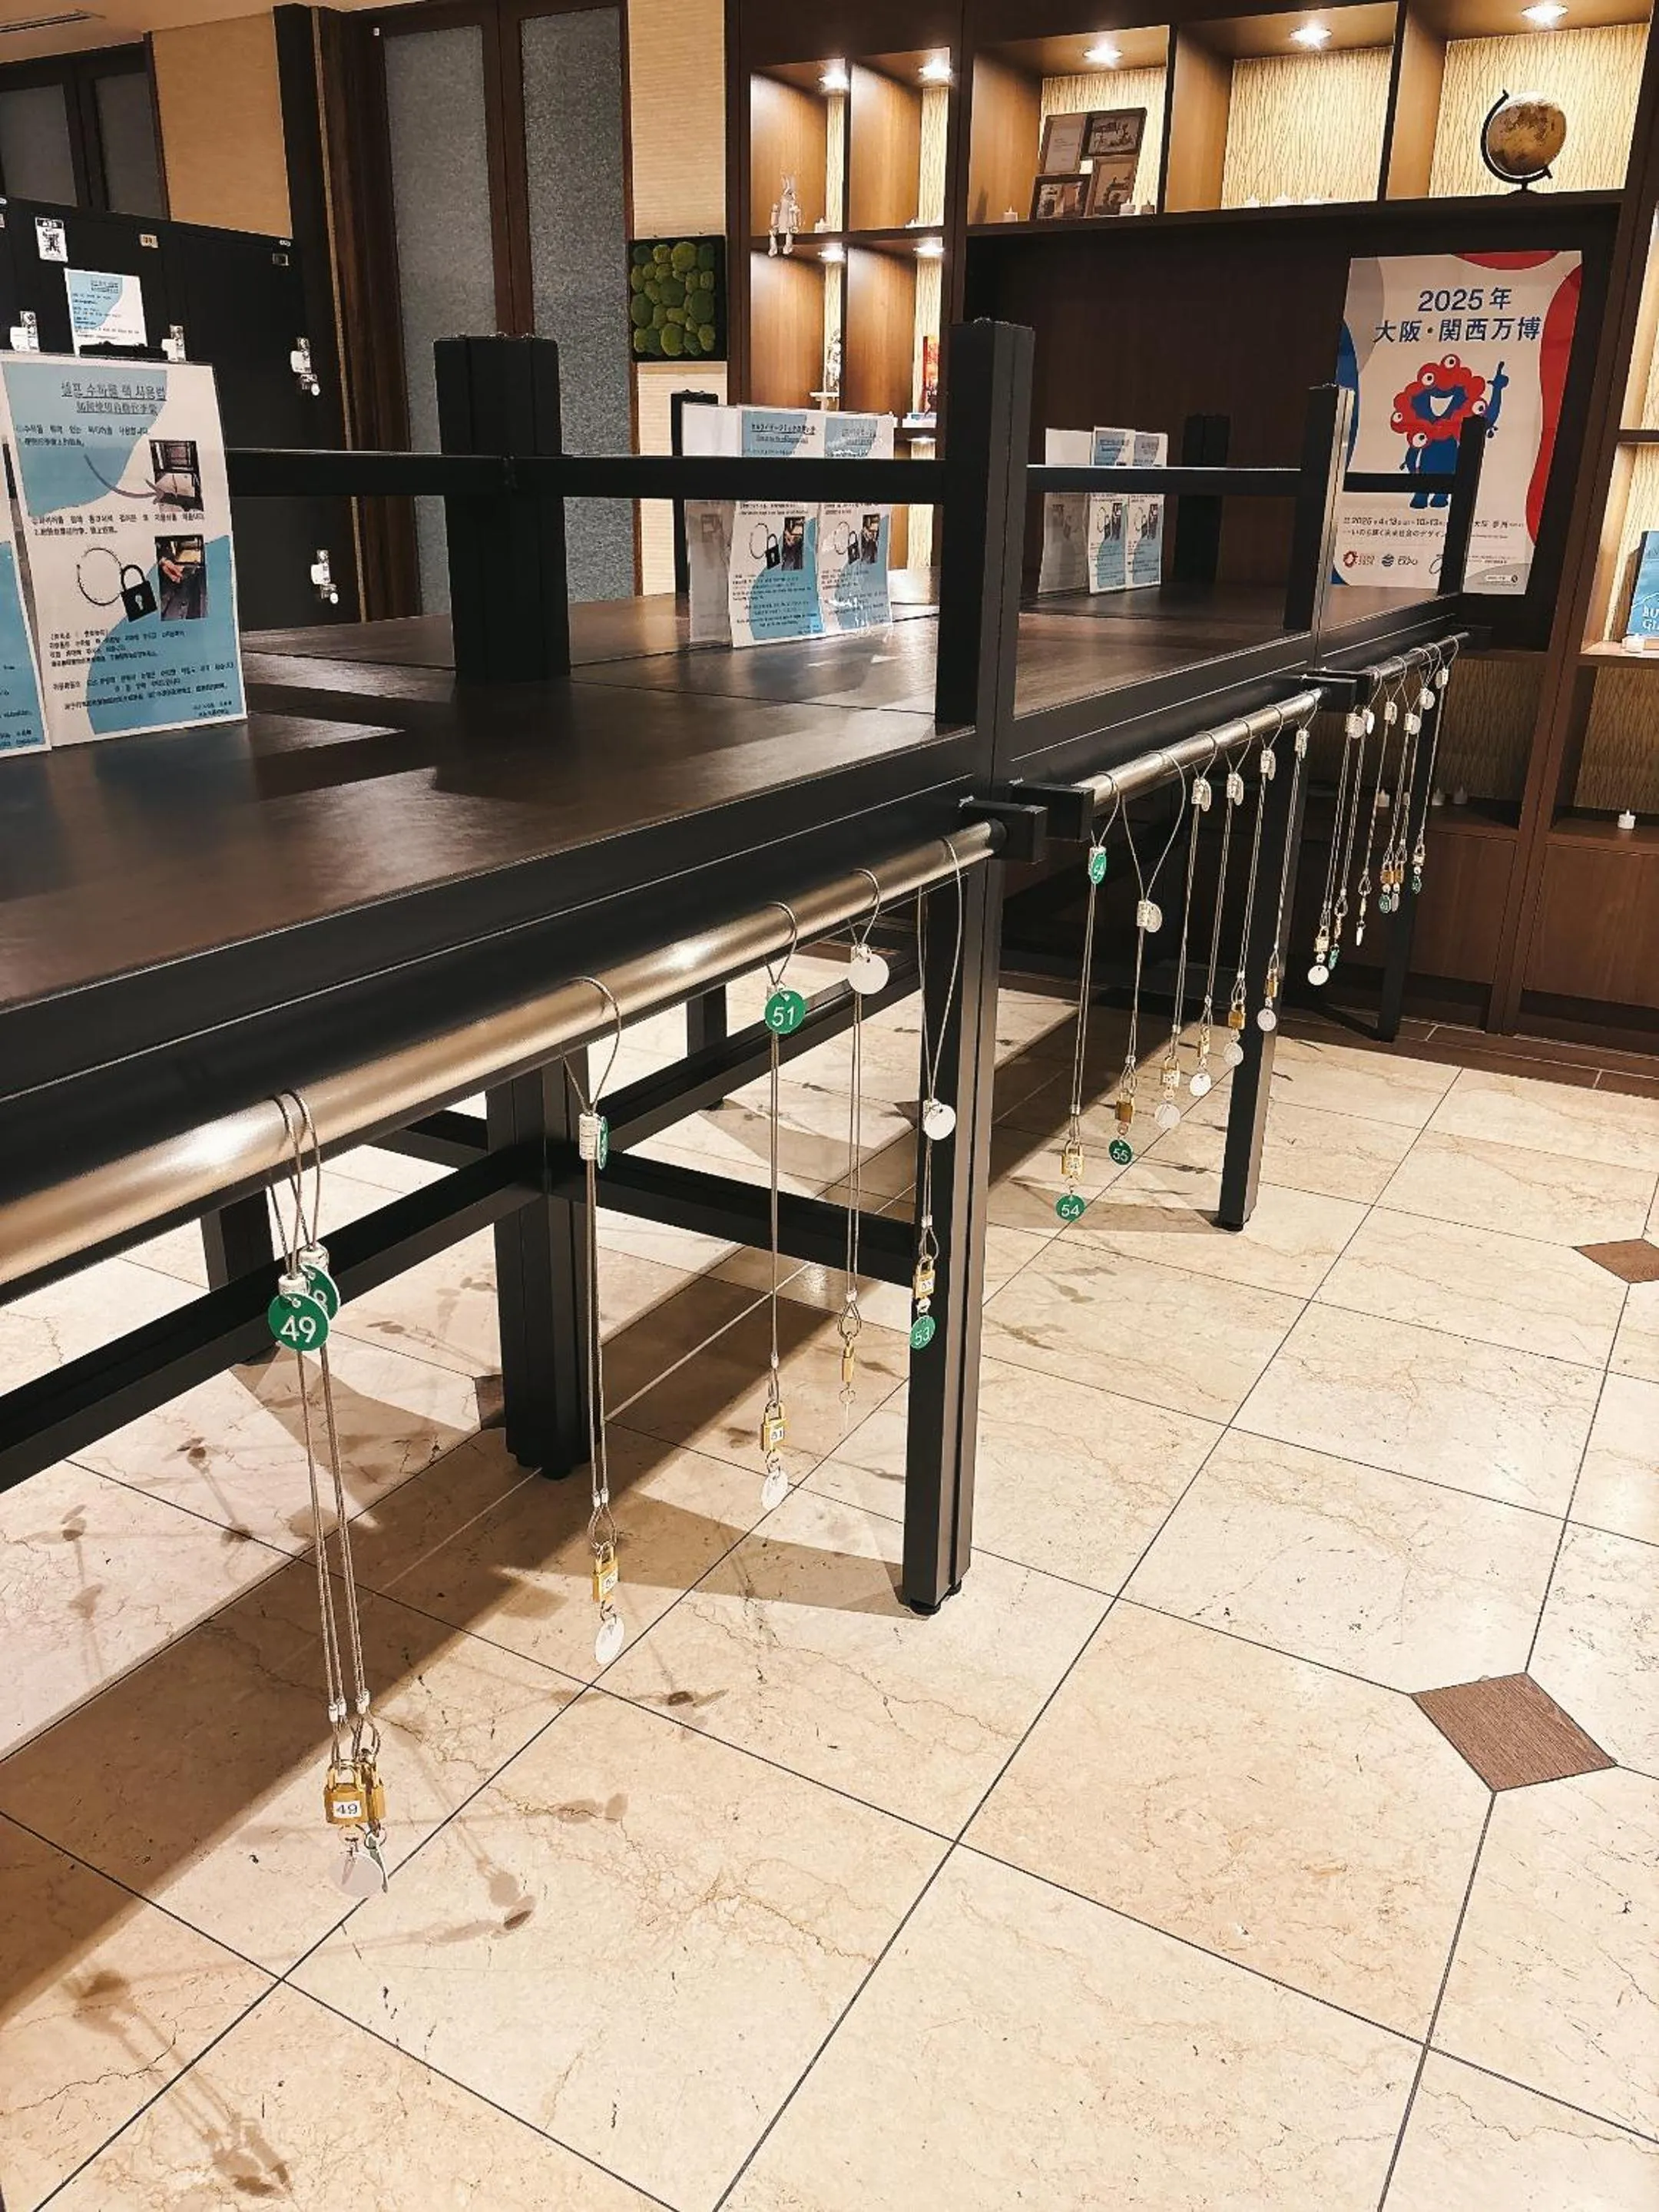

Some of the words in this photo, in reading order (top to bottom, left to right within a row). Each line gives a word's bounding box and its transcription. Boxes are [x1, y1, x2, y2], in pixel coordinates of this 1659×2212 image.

[1373, 316, 1541, 343] 大阪・関西万博
[772, 1005, 795, 1027] 51
[1061, 1204, 1081, 1217] 54
[280, 1315, 316, 1343] 49
[914, 1326, 930, 1346] 53
[336, 1803, 359, 1816] 49
